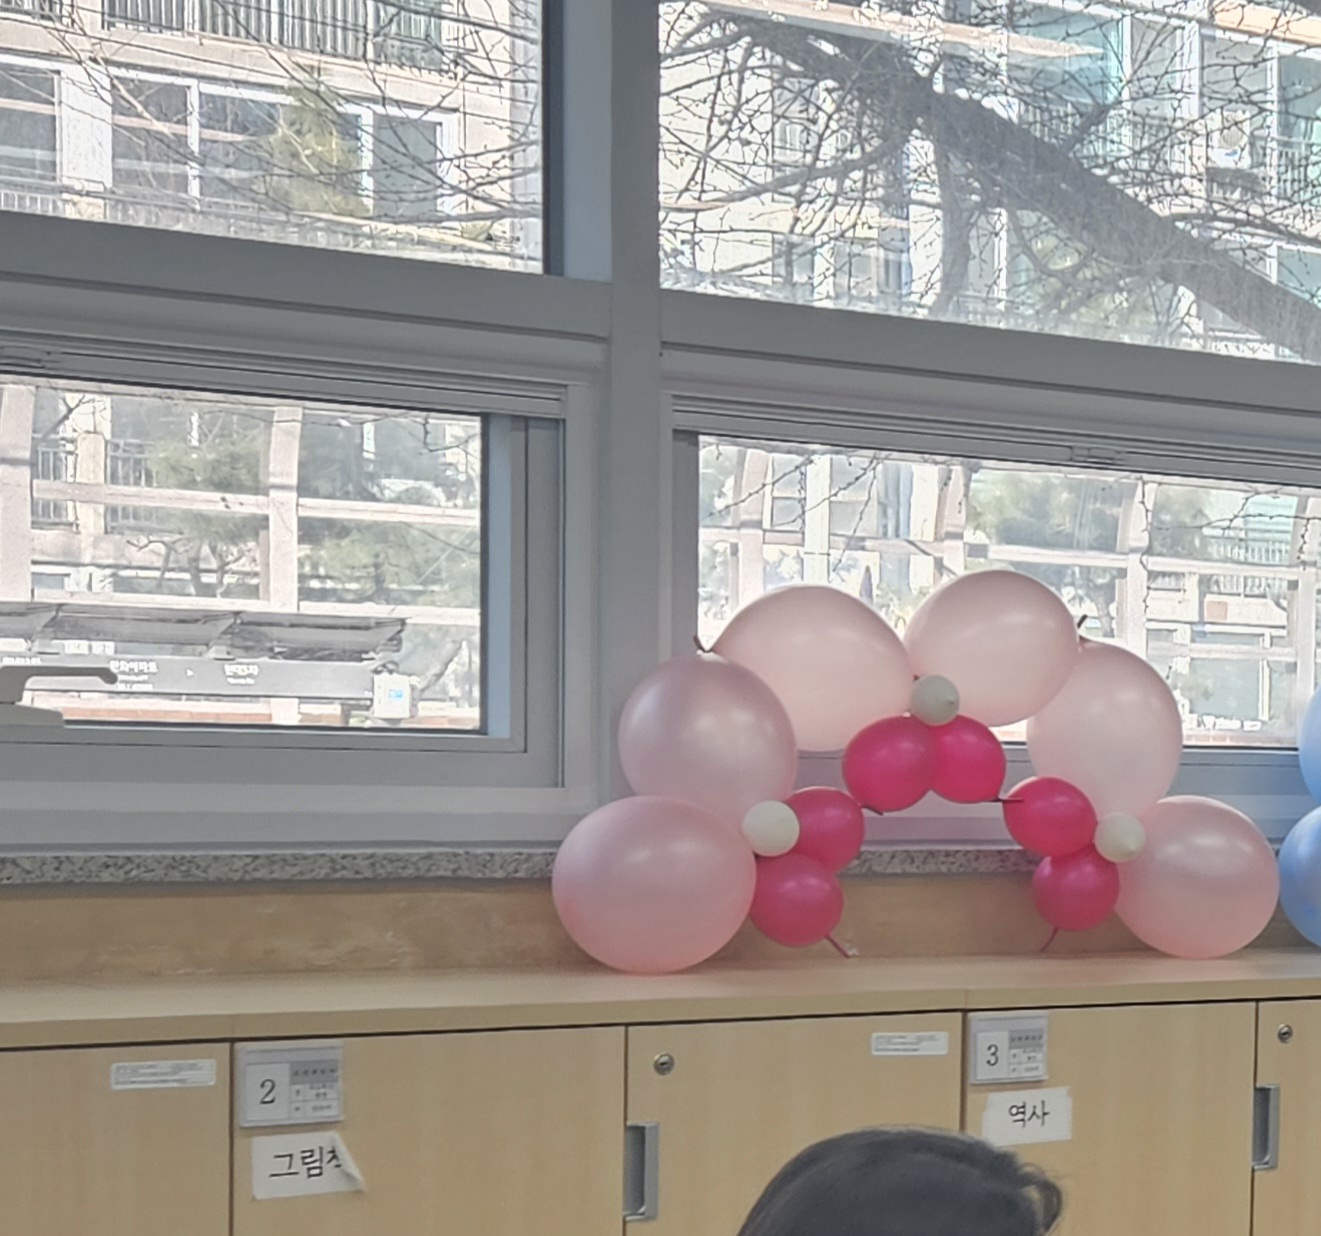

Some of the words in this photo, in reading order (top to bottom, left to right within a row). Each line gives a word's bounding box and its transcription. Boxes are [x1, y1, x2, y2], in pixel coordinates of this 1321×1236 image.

[985, 1043, 1000, 1067] 3
[259, 1078, 277, 1105] 2
[1007, 1099, 1051, 1129] 역사
